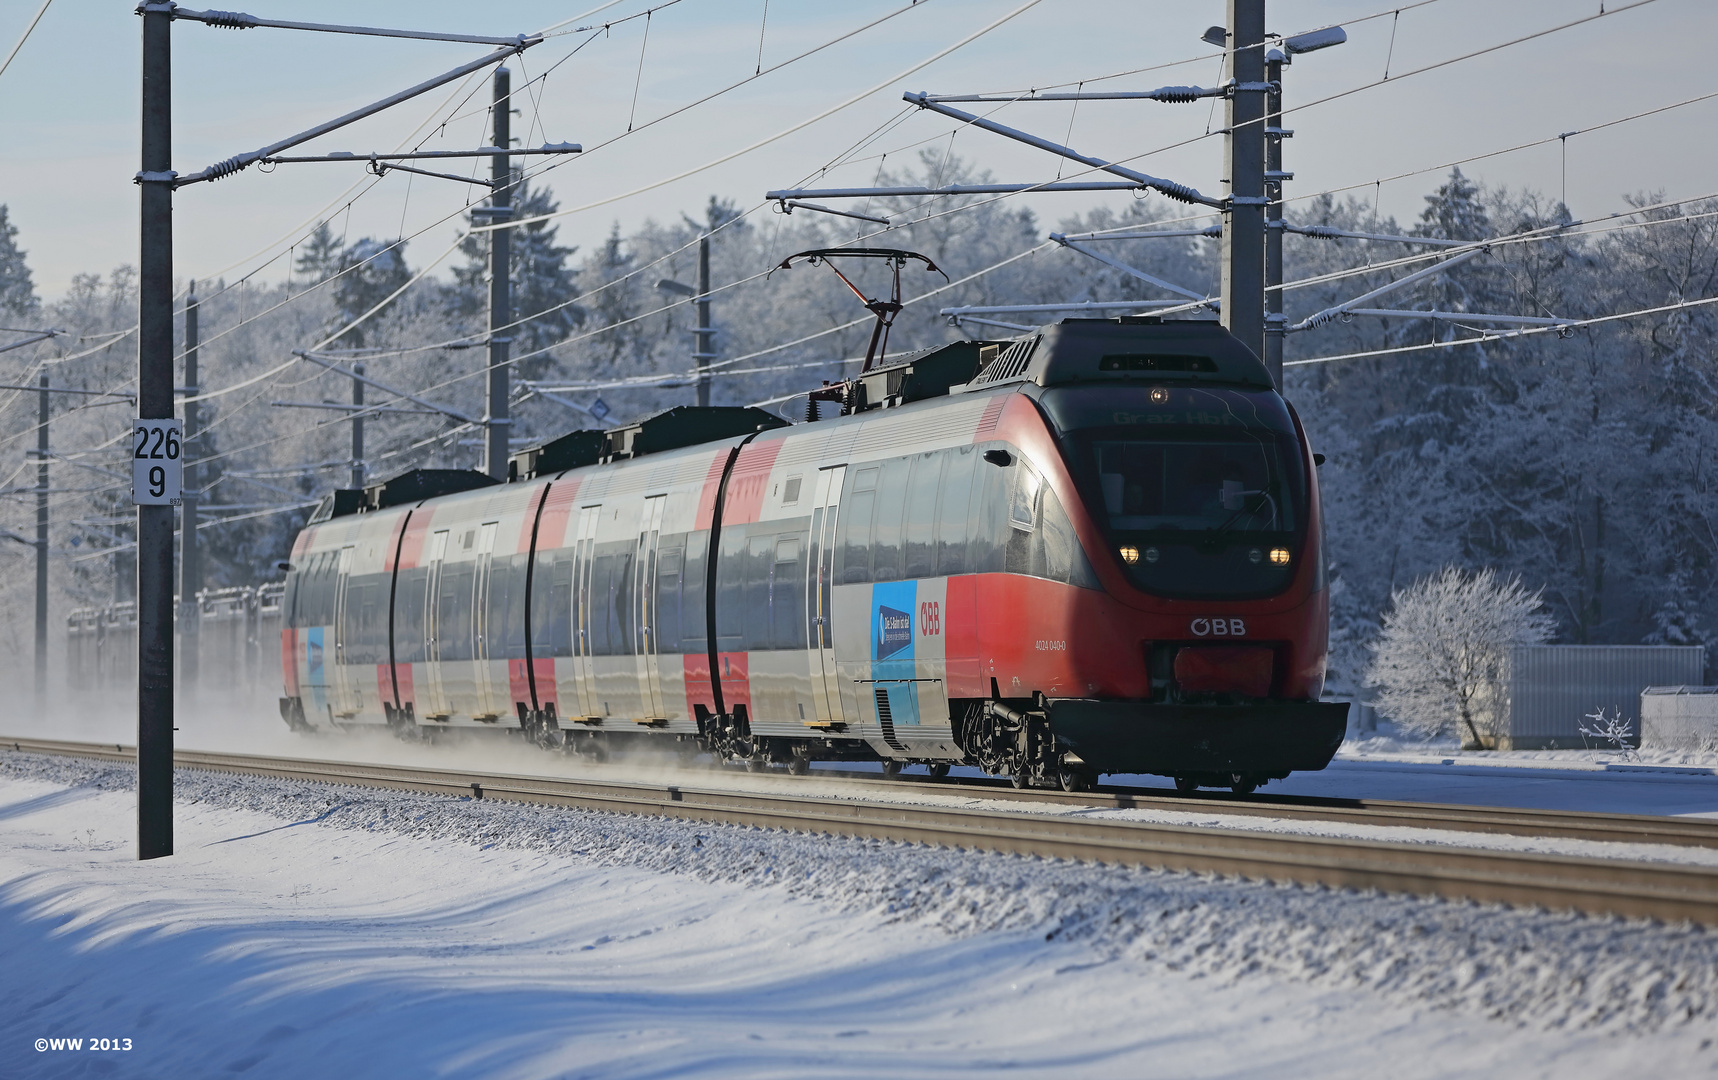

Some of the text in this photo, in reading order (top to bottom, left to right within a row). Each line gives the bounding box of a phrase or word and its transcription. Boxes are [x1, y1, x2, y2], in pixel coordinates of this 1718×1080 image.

[1113, 411, 1232, 425] Graz Hbf
[135, 427, 180, 460] 226
[149, 465, 165, 498] 9
[921, 601, 940, 636] ÖBB
[1190, 618, 1246, 636] ÖBB
[1035, 640, 1066, 650] 4024 040-0
